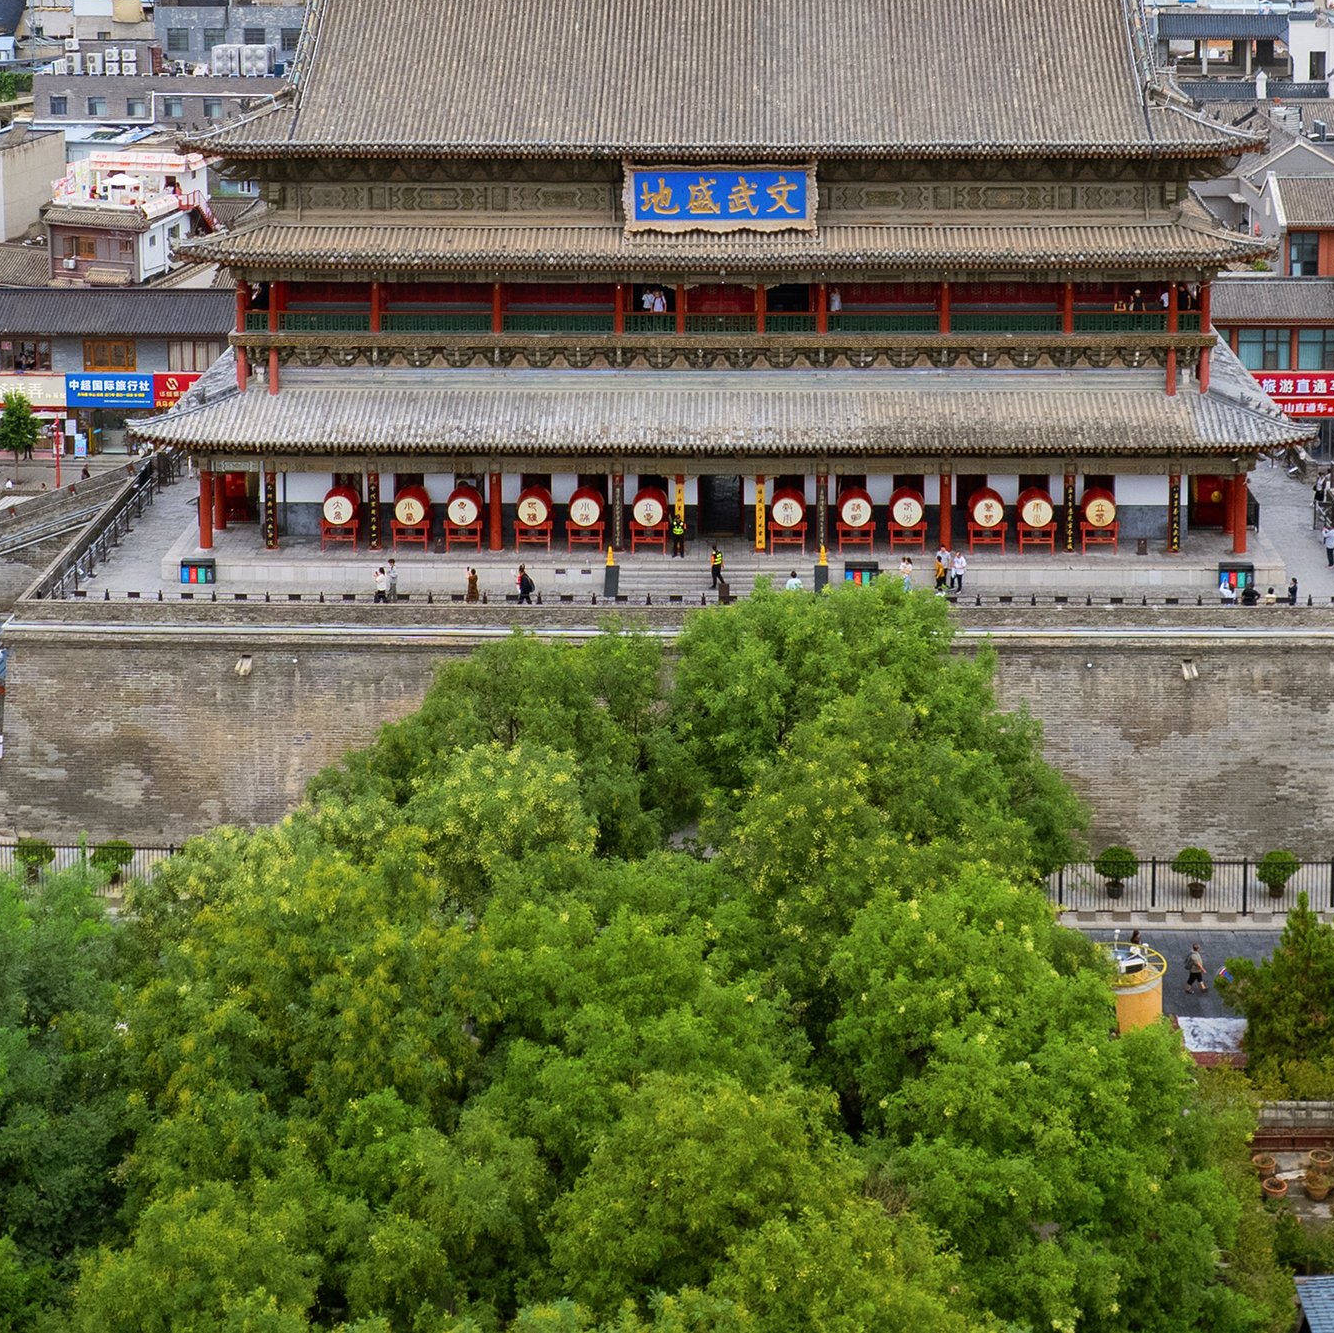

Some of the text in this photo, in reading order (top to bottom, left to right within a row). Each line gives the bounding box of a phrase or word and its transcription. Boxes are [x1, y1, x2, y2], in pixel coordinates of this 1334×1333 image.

[640, 176, 801, 216] 文武盛地
[69, 379, 150, 392] 中超国际旅行社
